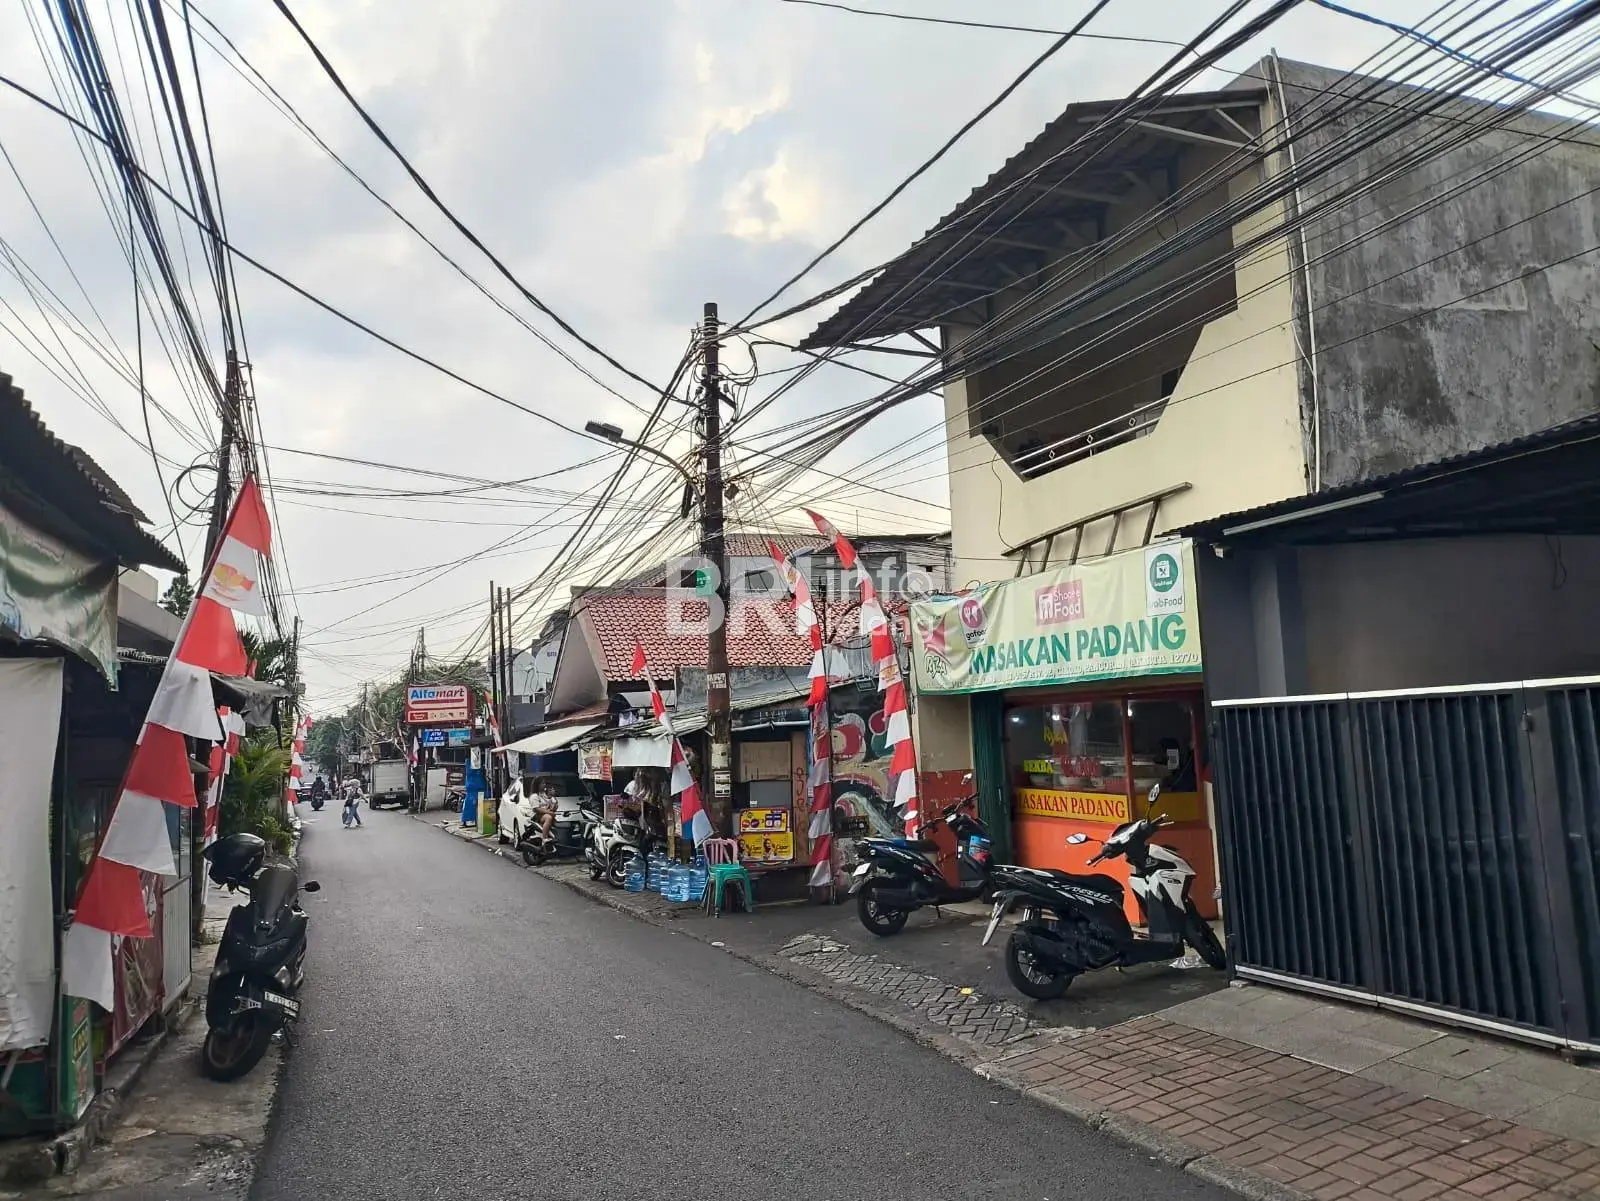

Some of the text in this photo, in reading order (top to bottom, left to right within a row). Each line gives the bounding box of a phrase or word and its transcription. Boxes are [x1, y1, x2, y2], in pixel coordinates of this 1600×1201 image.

[1054, 602, 1081, 617] Food
[969, 613, 1187, 675] MASAKAN PADANG
[411, 687, 465, 699] Alfamart
[1071, 797, 1125, 819] PADANG
